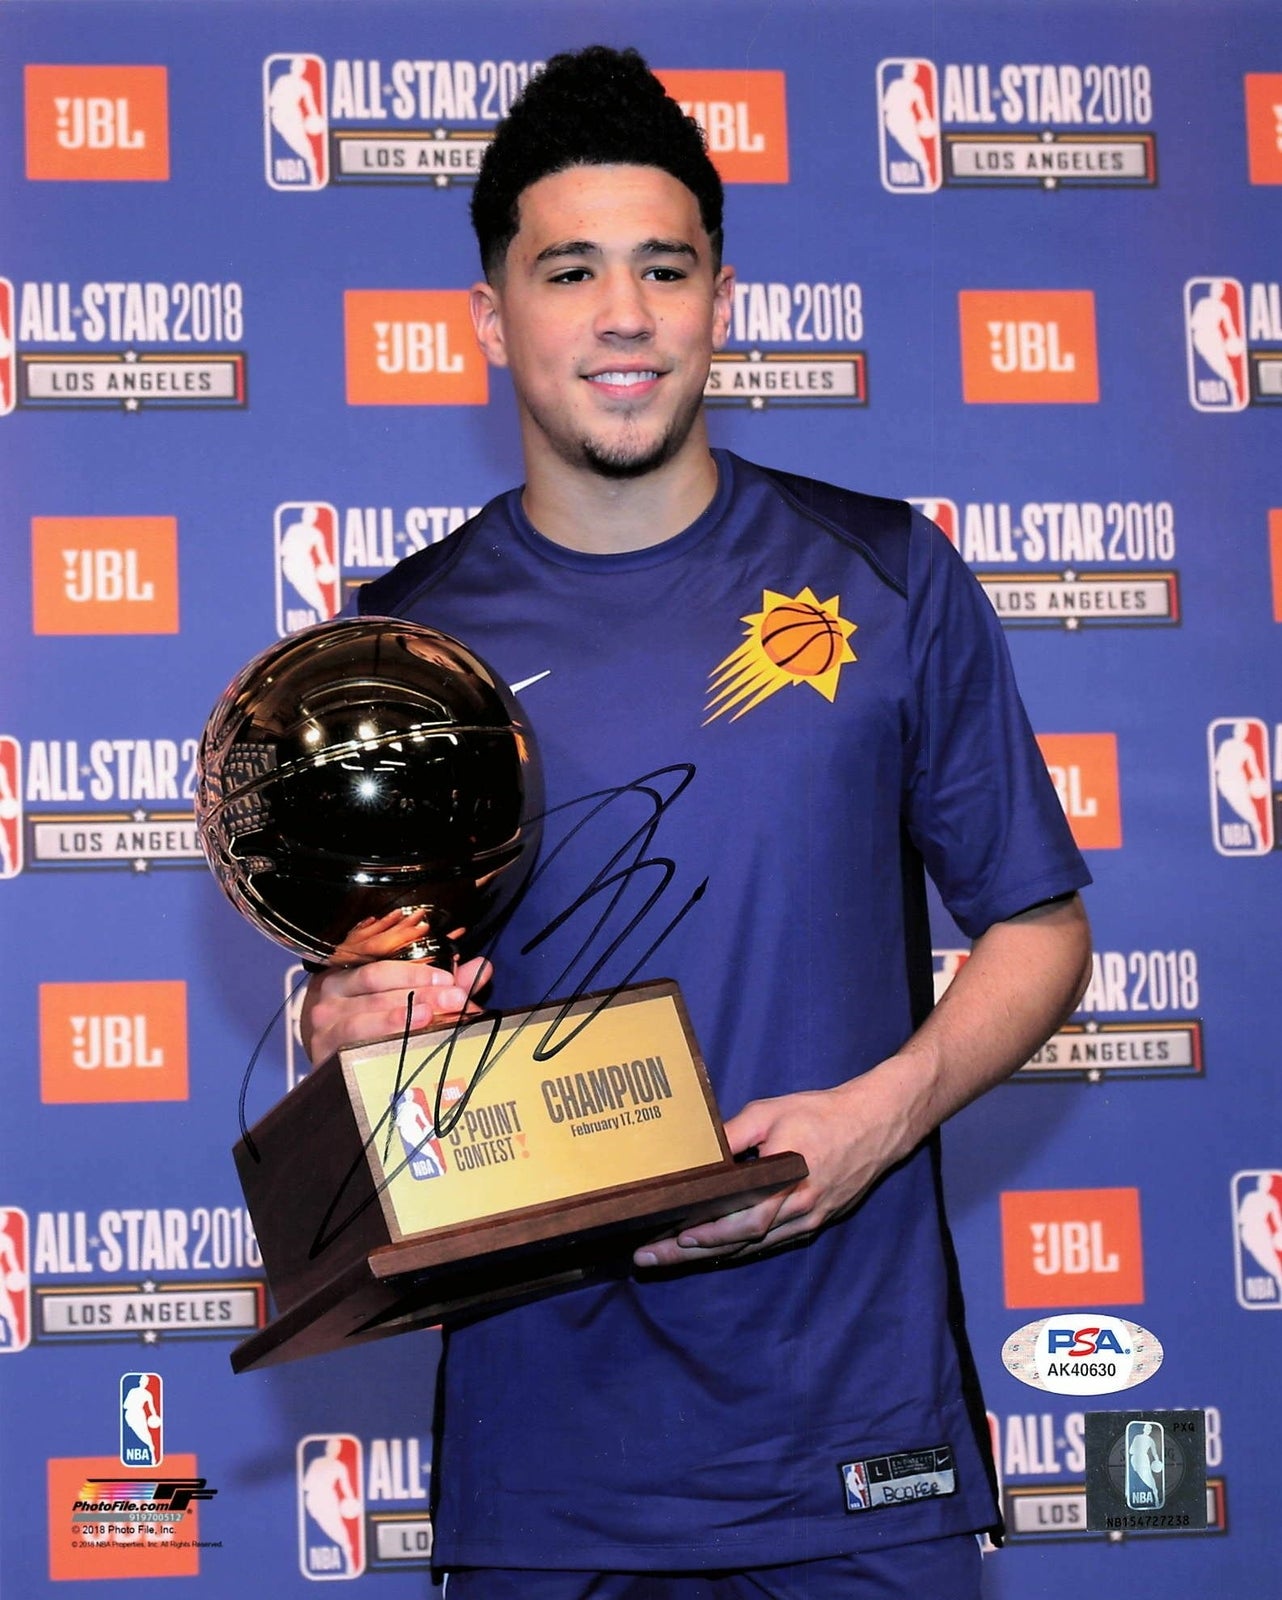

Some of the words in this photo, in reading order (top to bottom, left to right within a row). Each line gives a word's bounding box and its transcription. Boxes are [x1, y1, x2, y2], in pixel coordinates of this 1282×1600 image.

[57, 98, 144, 149] JBL
[363, 148, 405, 168] LOS
[417, 148, 483, 168] ANGE
[974, 151, 1015, 170] LOS
[1026, 151, 1125, 170] ANGELES
[375, 322, 463, 374] JBL
[990, 321, 1074, 373] JBL
[52, 372, 95, 391] LOS
[106, 372, 212, 391] ANGELES
[733, 370, 834, 390] ANGELES
[64, 550, 154, 602] JBL
[997, 591, 1037, 612] LOS
[1049, 590, 1147, 611] ANGELES
[60, 832, 103, 853] LOS
[71, 1016, 163, 1070] JBL
[1070, 1041, 1170, 1062] ANGELES
[540, 1056, 673, 1124] CHAMPION
[571, 1115, 619, 1138] February
[620, 1111, 635, 1128] 17,
[635, 1105, 662, 1124] 2018
[453, 1136, 516, 1172] CONTEST
[412, 1158, 435, 1177] NBA
[1031, 1222, 1118, 1275] JBL
[68, 1303, 112, 1325] LOS
[125, 1299, 232, 1323] ANGELES
[1038, 1500, 1081, 1525] LOS
[402, 1531, 428, 1552] LO
